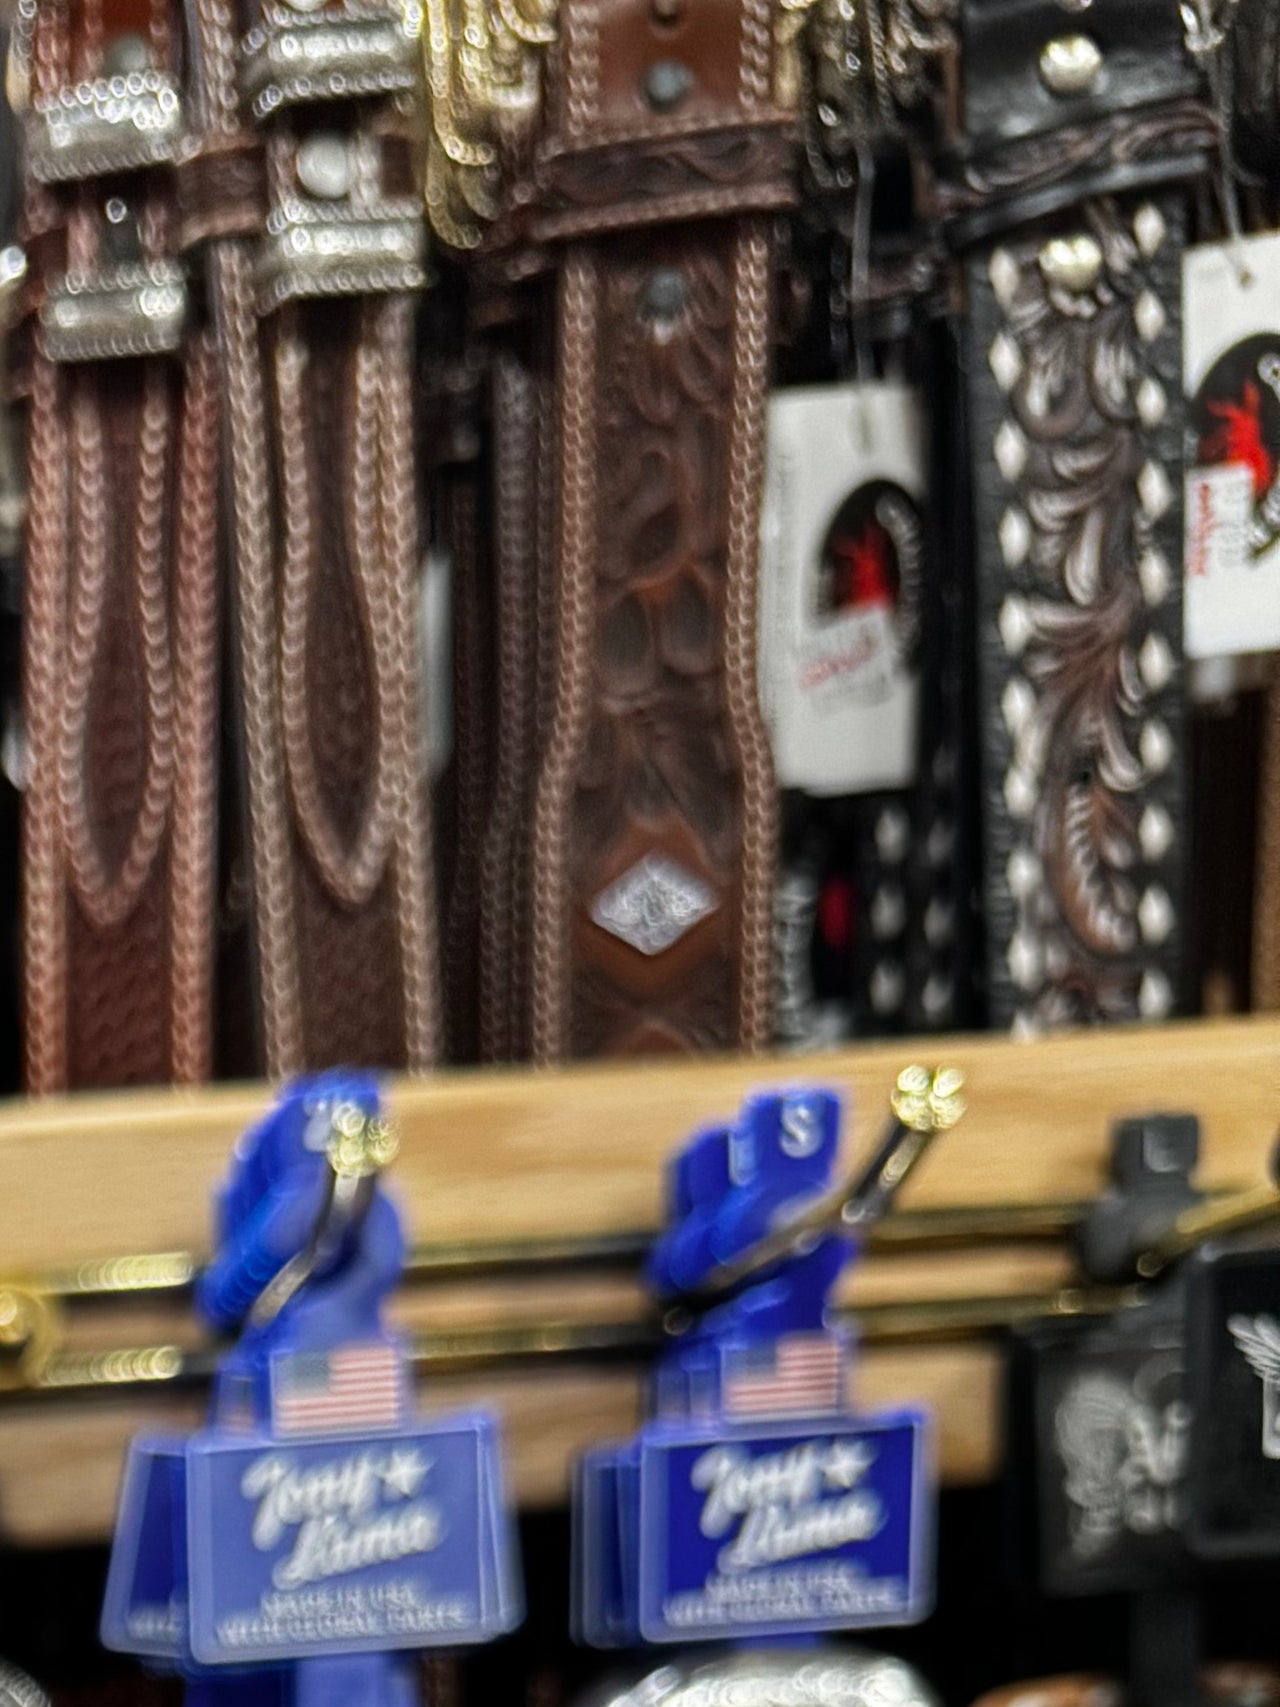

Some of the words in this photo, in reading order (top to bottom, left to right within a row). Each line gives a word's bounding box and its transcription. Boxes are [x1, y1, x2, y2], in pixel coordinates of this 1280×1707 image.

[781, 1099, 823, 1158] S
[241, 1452, 380, 1550] Tony
[690, 1443, 818, 1540] Tony
[717, 1488, 887, 1575] Lama
[272, 1500, 448, 1590] Lama
